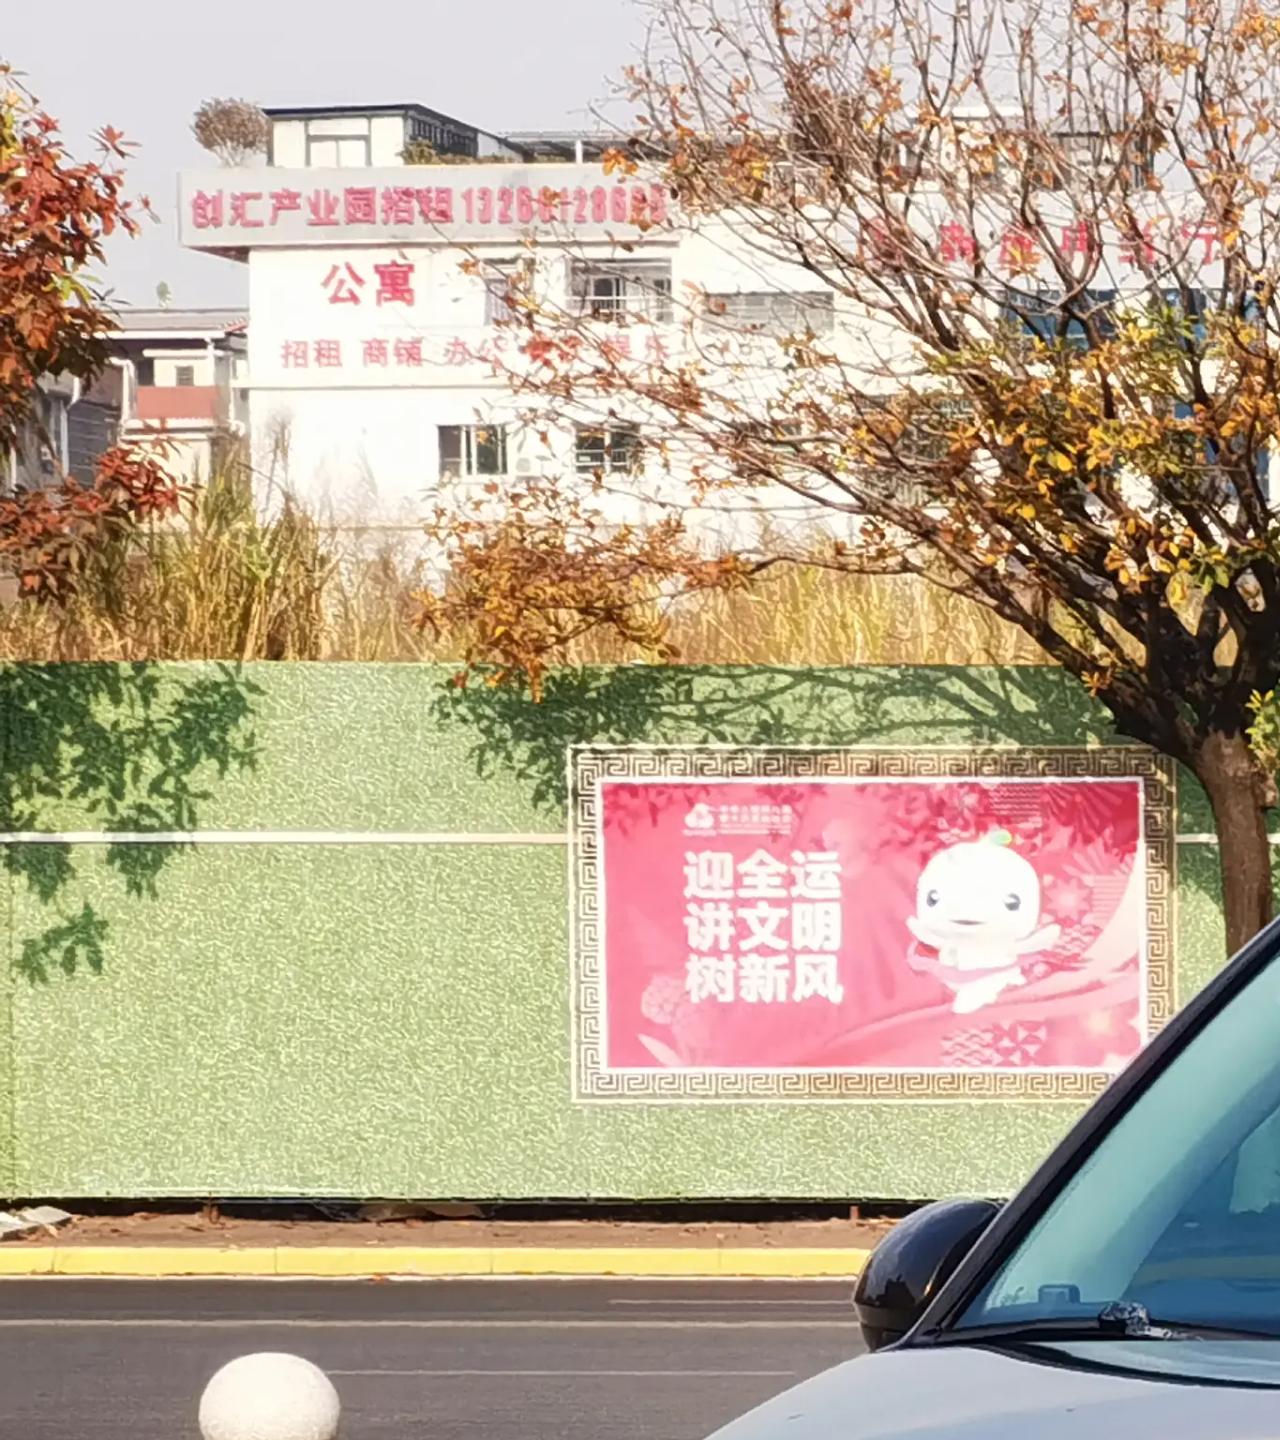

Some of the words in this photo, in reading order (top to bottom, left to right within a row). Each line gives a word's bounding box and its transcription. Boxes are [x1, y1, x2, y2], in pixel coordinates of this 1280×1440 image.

[321, 260, 415, 306] 公寓
[281, 339, 342, 368] 招租
[683, 848, 842, 900] 迎全运
[683, 902, 842, 952] 讲文明
[685, 953, 844, 1005] 树新风
